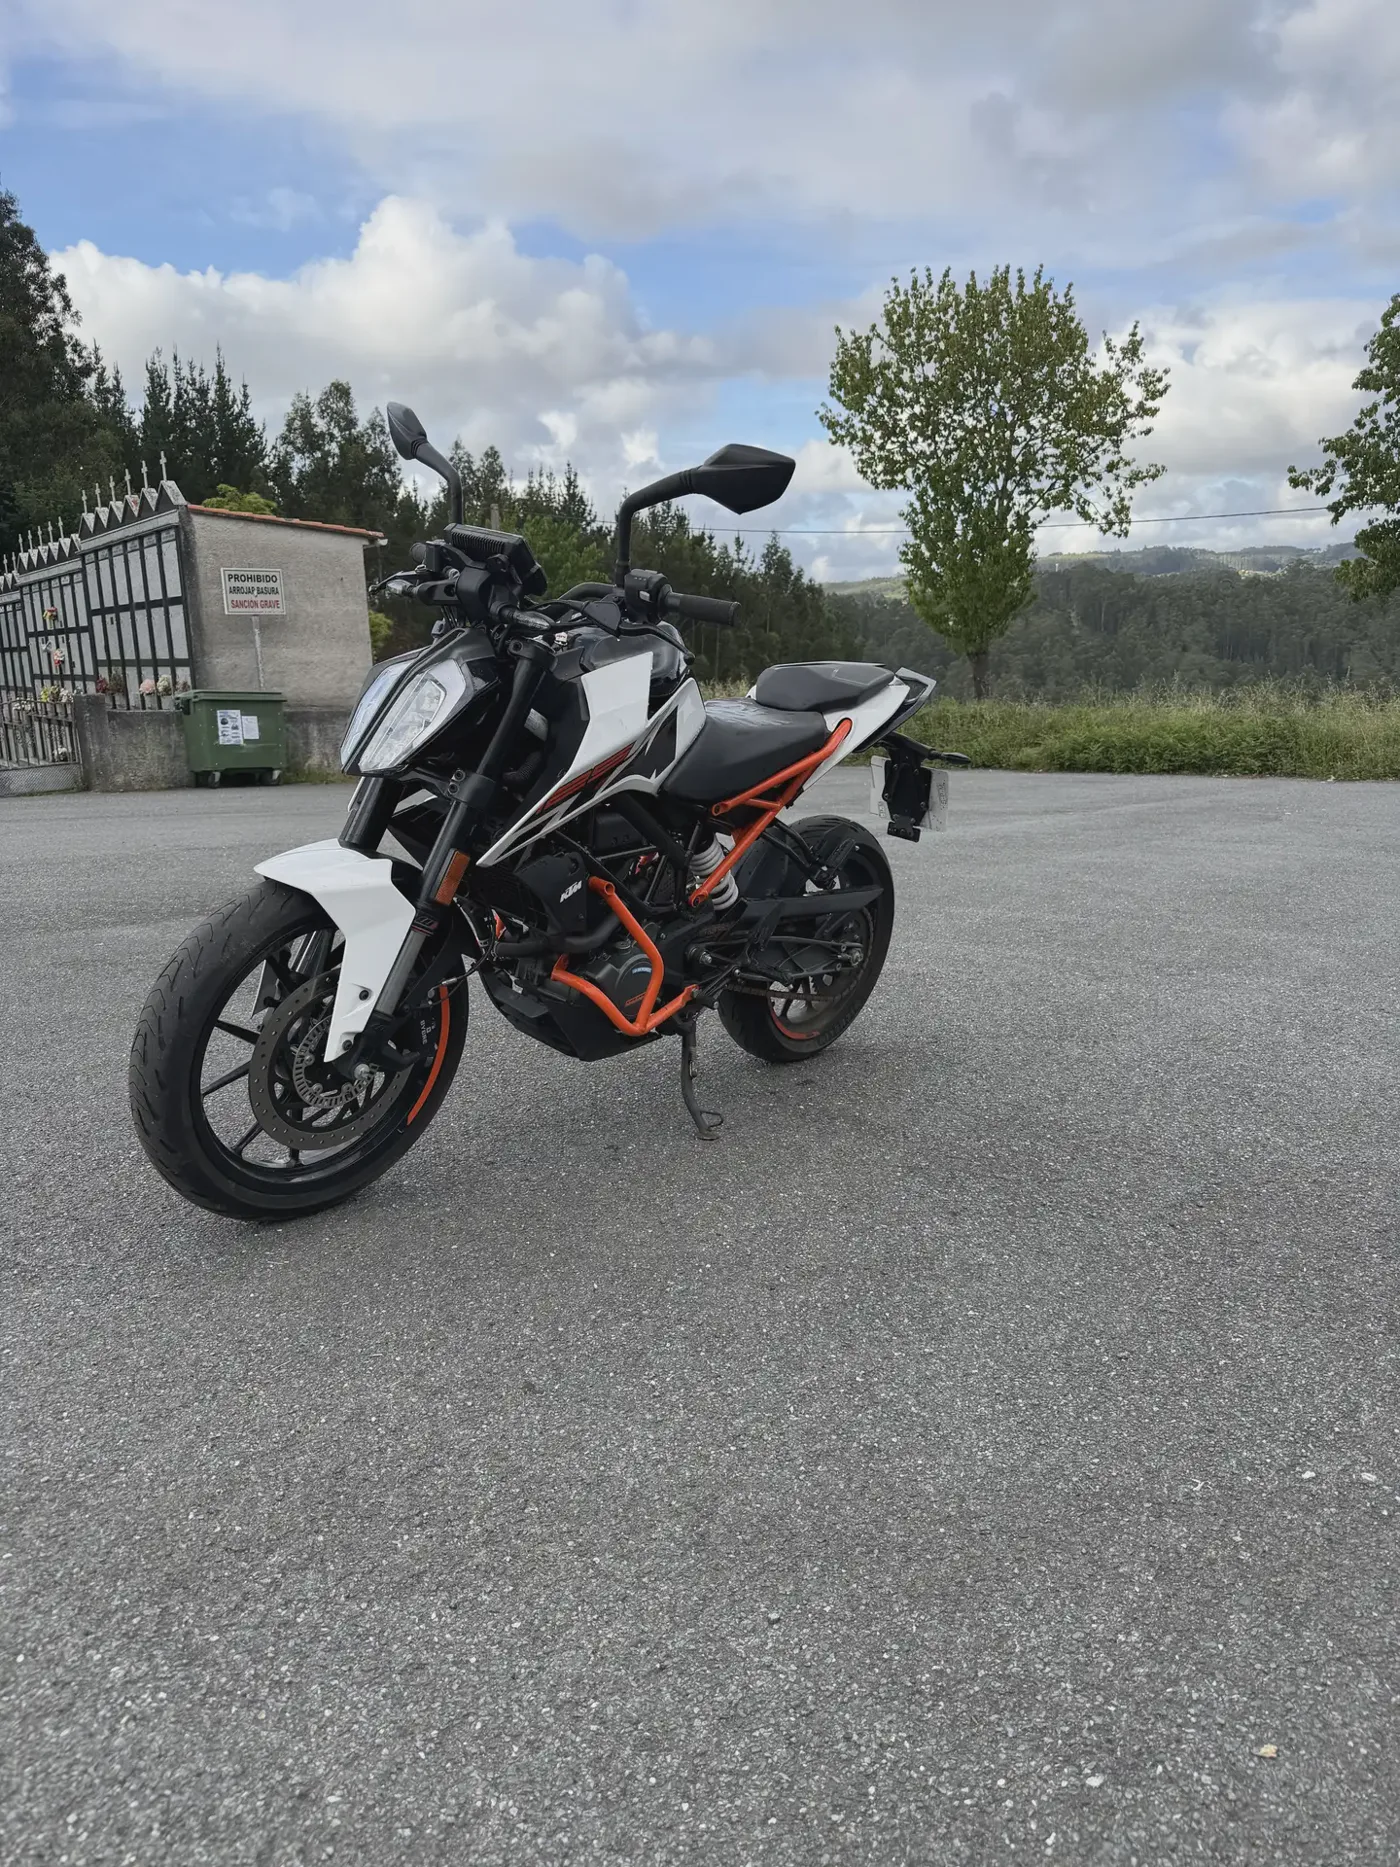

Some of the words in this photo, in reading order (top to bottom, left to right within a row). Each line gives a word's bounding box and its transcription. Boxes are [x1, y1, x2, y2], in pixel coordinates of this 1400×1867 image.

[228, 574, 278, 583] PROHIBIDO
[256, 586, 279, 595] BASURA
[260, 600, 280, 609] GRAVE
[560, 880, 582, 903] KTM
